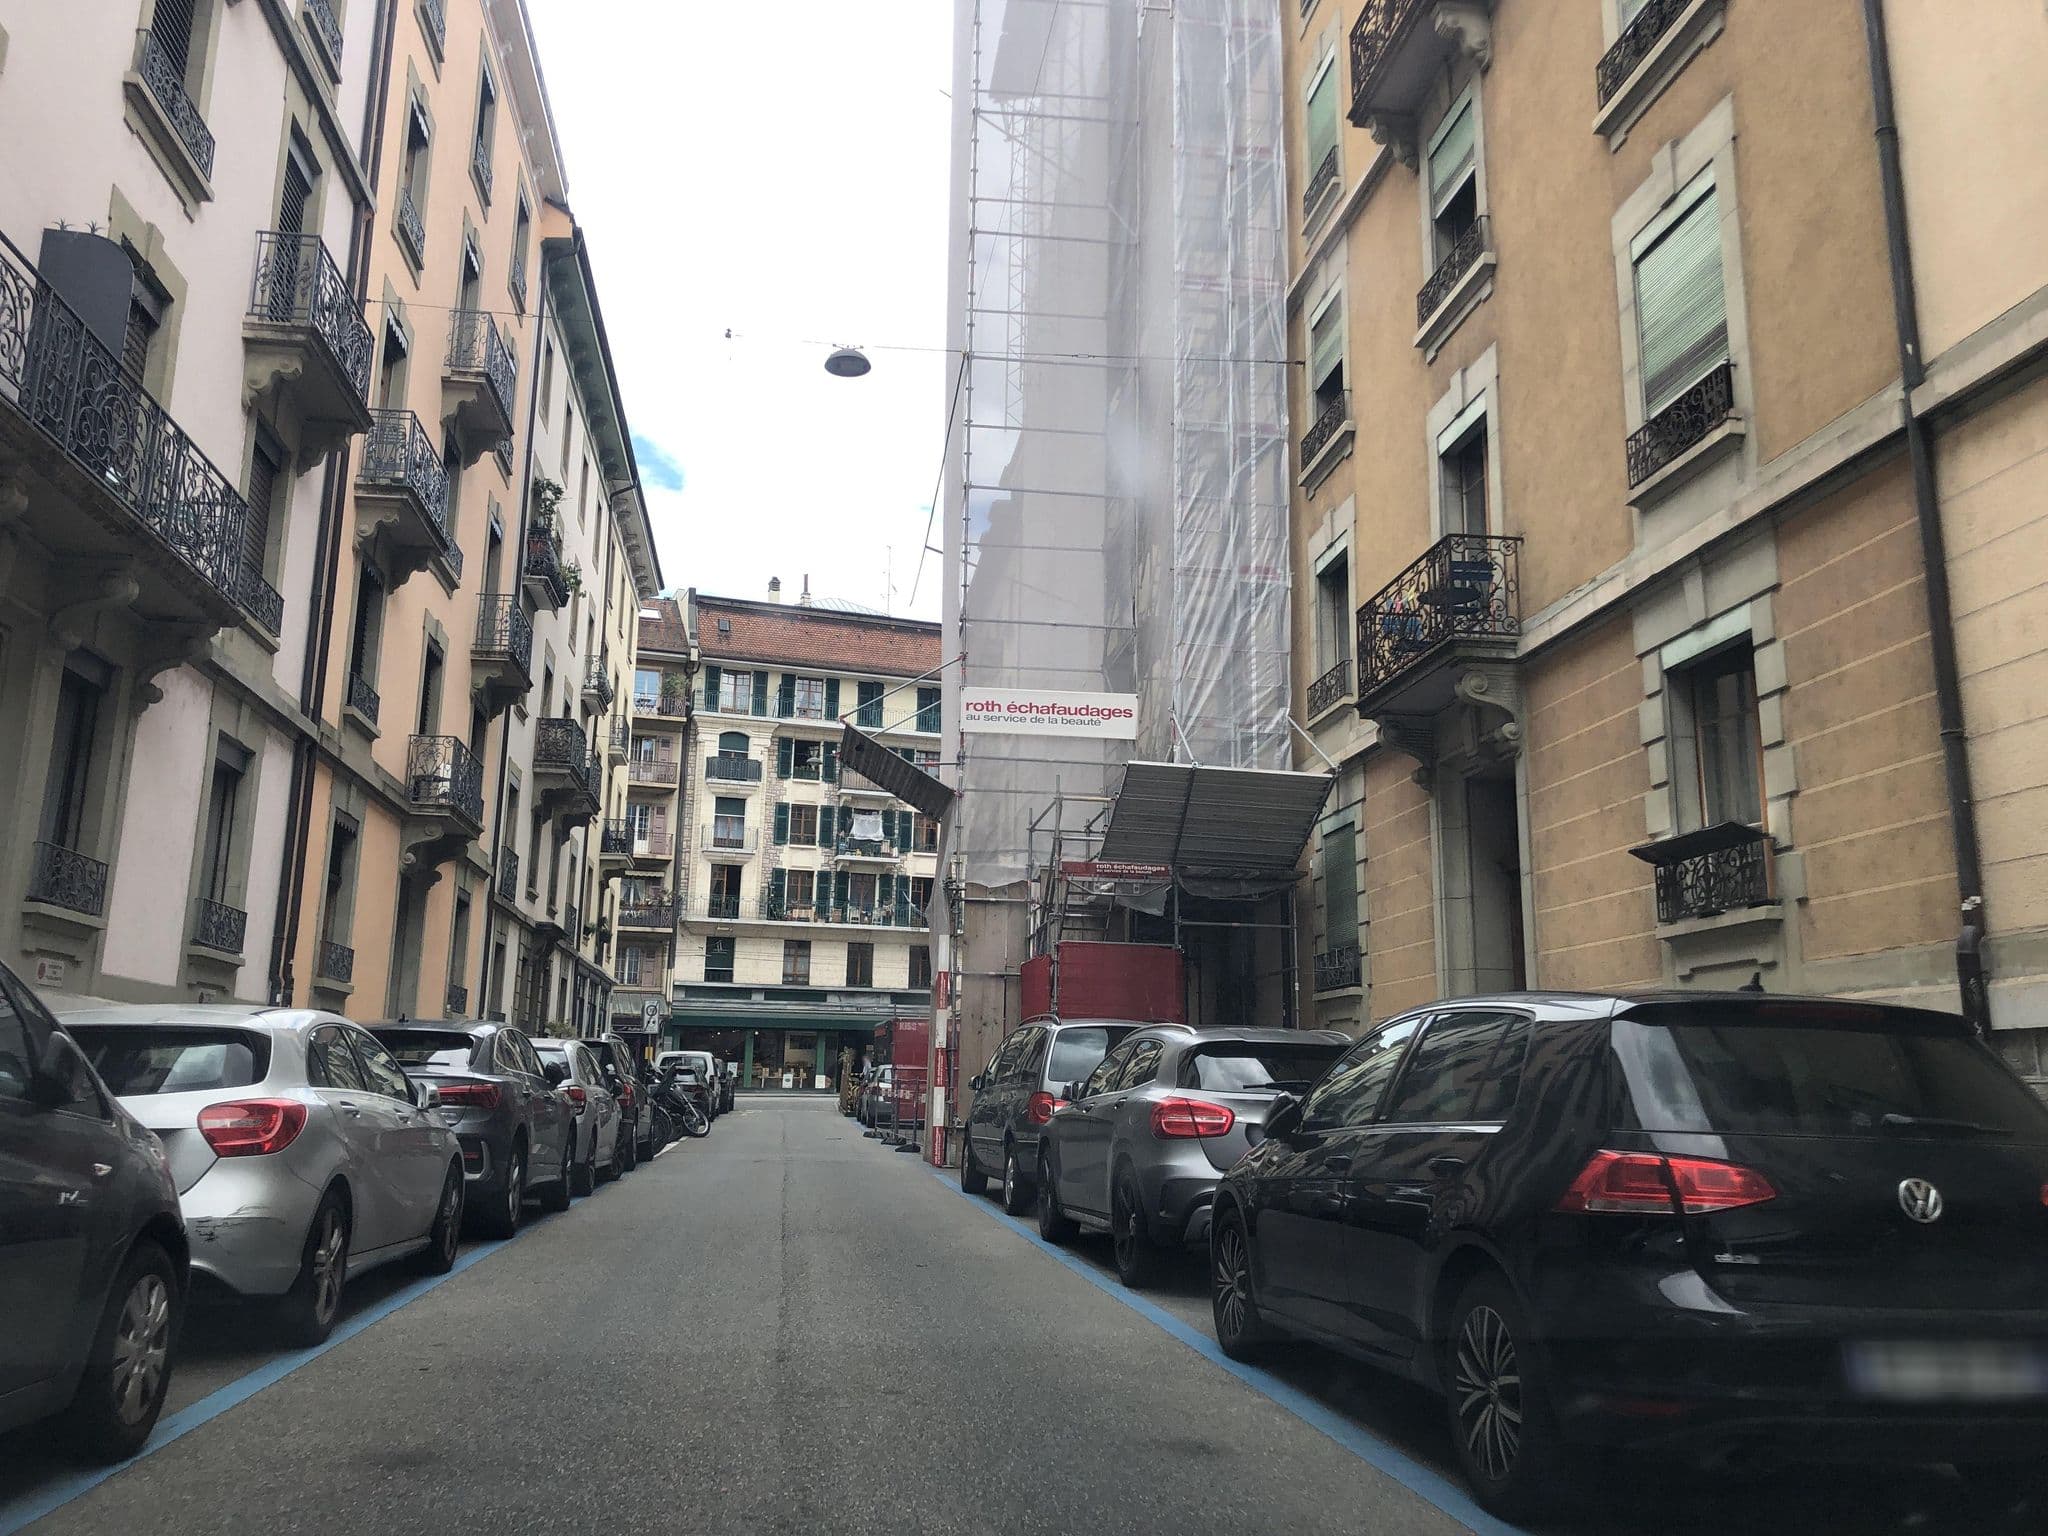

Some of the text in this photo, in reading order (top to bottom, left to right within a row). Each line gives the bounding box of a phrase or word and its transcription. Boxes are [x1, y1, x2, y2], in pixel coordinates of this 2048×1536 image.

[965, 700, 1133, 720] roth échafaudages
[965, 713, 1101, 727] au service de la beauté
